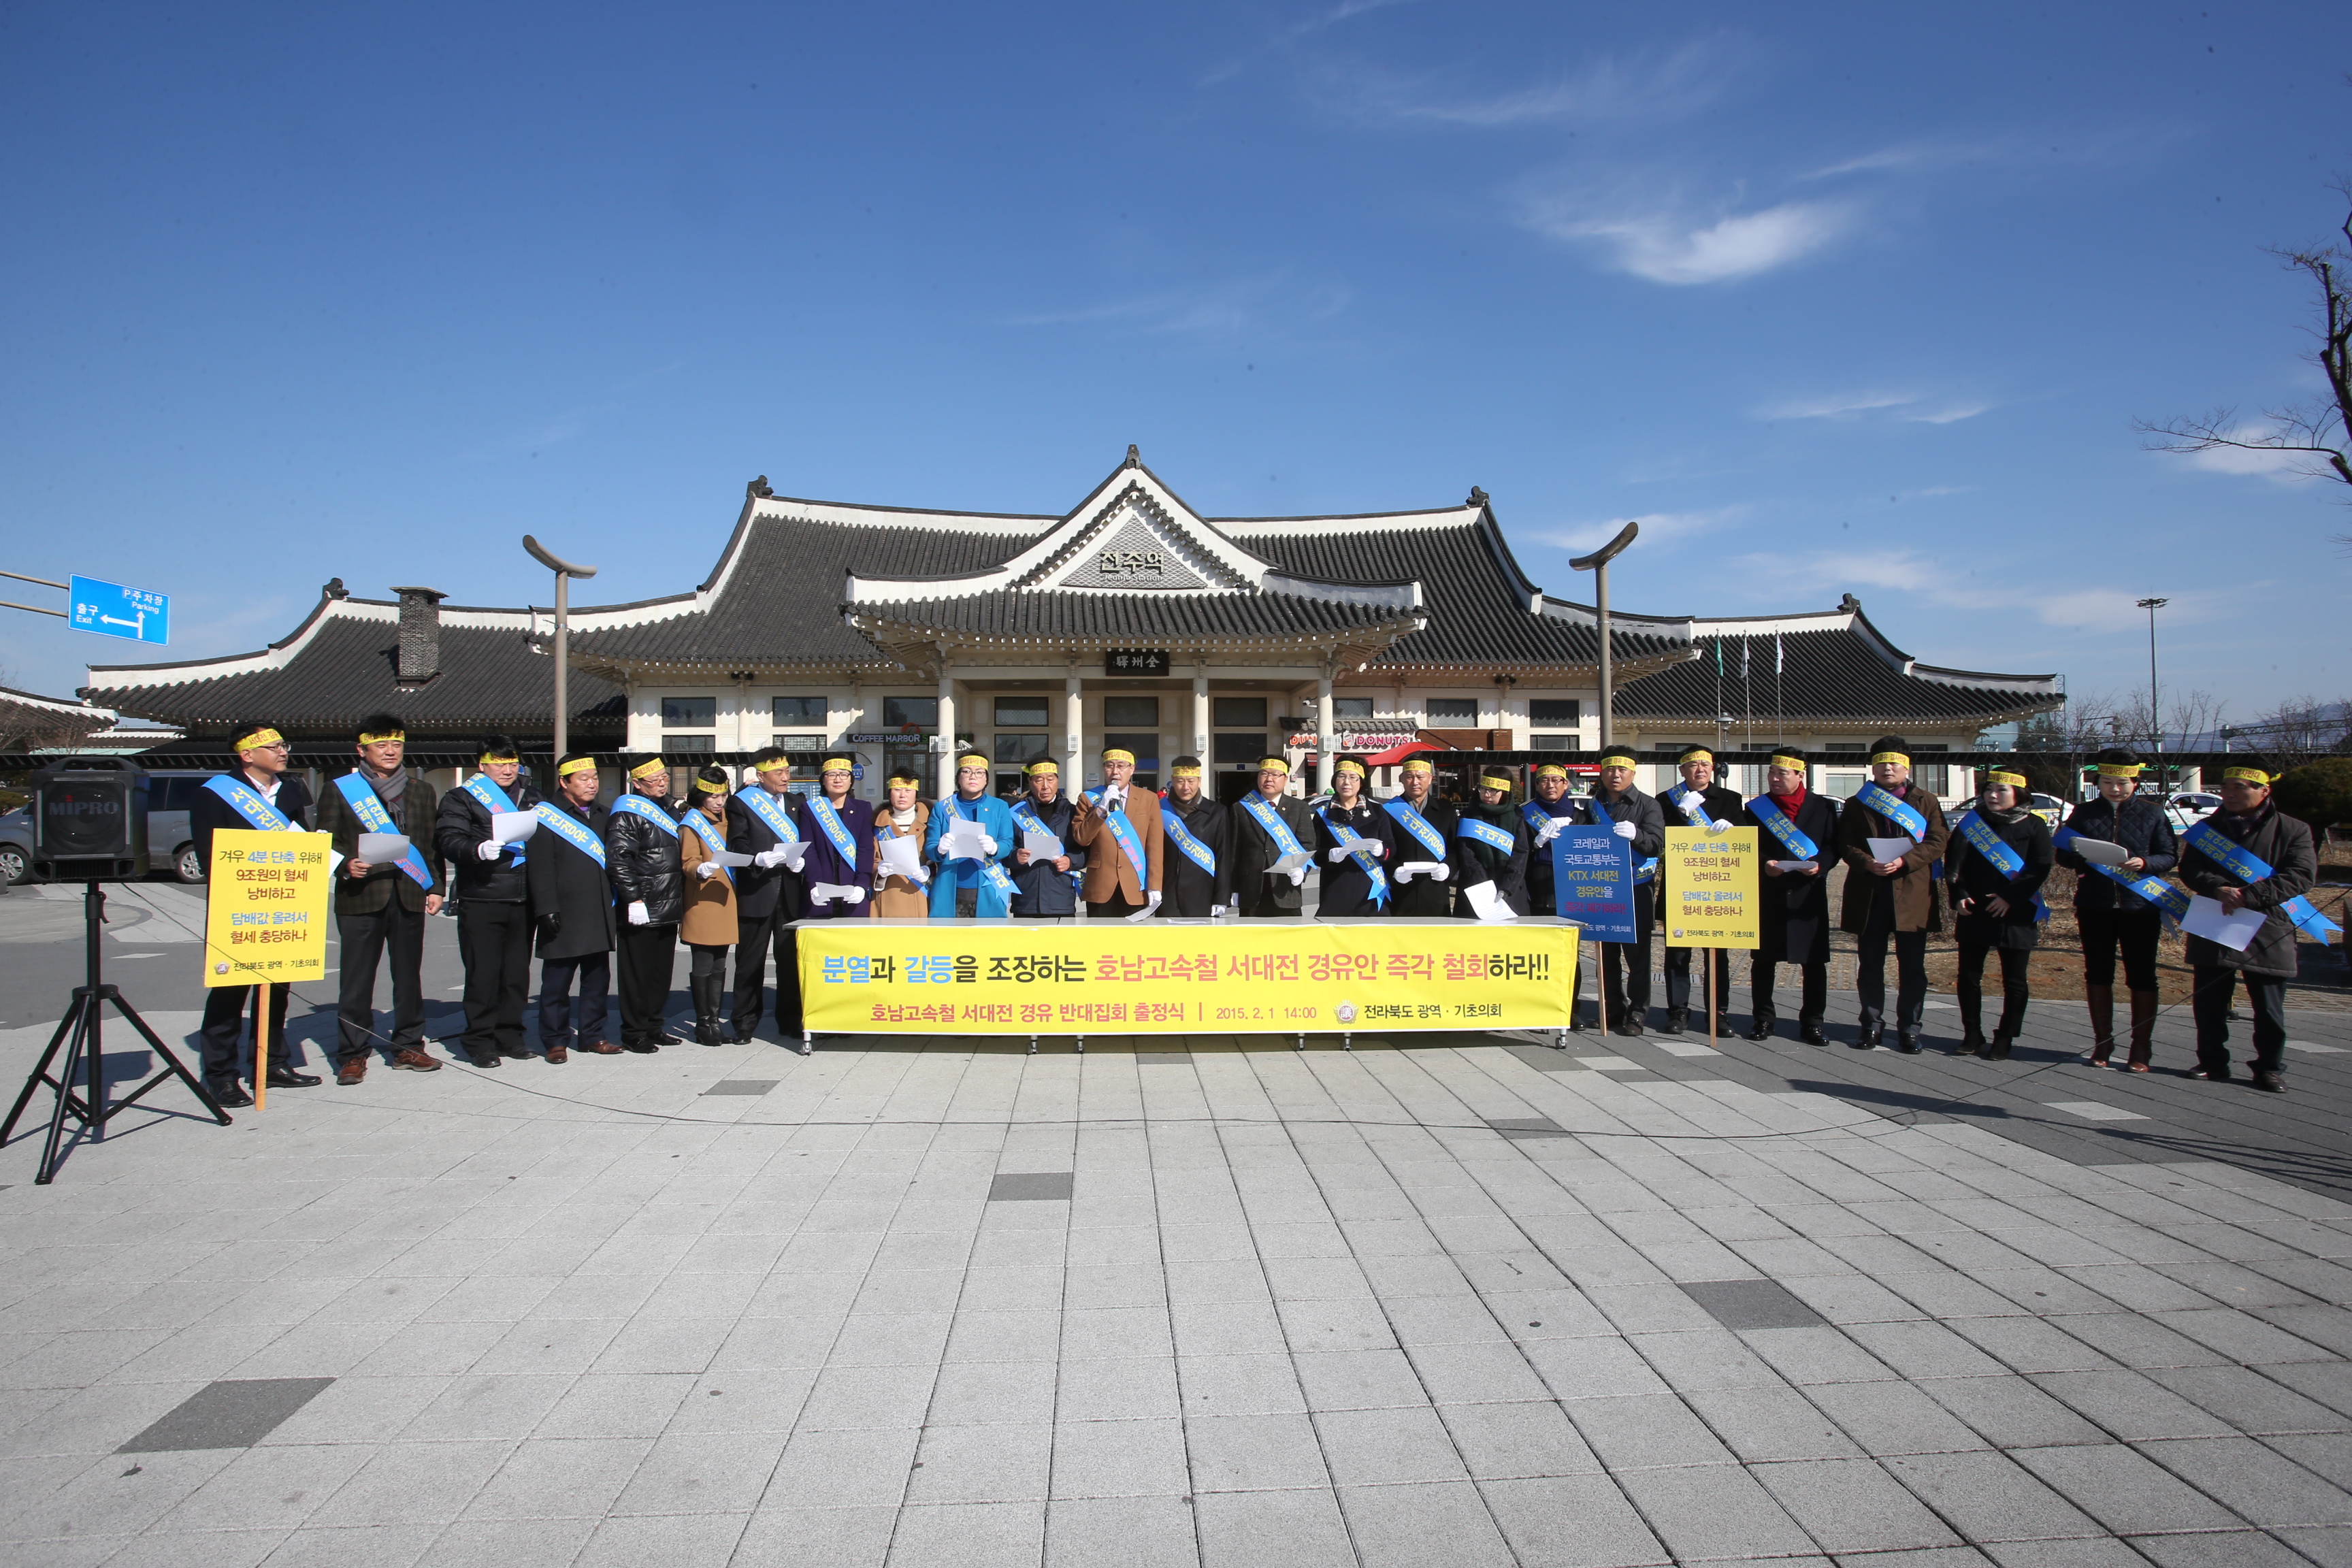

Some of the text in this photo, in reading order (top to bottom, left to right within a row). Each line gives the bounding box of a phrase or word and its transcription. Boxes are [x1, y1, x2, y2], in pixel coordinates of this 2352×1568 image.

[1100, 551, 1165, 574] 전주역
[1133, 574, 1163, 582] Station
[132, 589, 163, 606] 주차장
[77, 603, 99, 616] 출구
[131, 601, 160, 615] Parking
[76, 615, 93, 624] Exit
[248, 733, 268, 745] 서대전
[852, 734, 884, 742] COFFEE
[885, 734, 921, 742] HARBOR
[1356, 735, 1409, 746] DONUTS
[571, 760, 587, 770] 서대전
[2234, 769, 2261, 780] 결사반대
[700, 782, 713, 791] 서대전
[714, 783, 723, 792] 경유
[1487, 778, 1495, 786] 경유
[472, 785, 493, 804] 사장
[1871, 787, 1903, 808] 최연혜
[353, 800, 379, 832] 코레일
[365, 795, 391, 825] 최연혜
[1866, 796, 1916, 830] 코레일 사장
[751, 793, 799, 844] 서대전경유
[812, 795, 847, 844] 서대전경유
[1108, 818, 1124, 836] 사장
[1401, 810, 1446, 856] 서대전경유
[1974, 819, 2002, 845] 최연혜
[1169, 819, 1212, 864] 서대전경유
[1573, 837, 1611, 850] 코레일과
[1765, 817, 1807, 858] 코레일 사장
[2204, 828, 2237, 852] 최연혜
[1671, 843, 1751, 853] 겨우 4분 단축 위해
[1965, 826, 2011, 871] 코레일 사장
[219, 849, 322, 864] 겨우 4분 단축 위해
[1564, 853, 1620, 866] 국토교통부는
[1683, 857, 1740, 868] 9조원의 혈세
[2195, 837, 2253, 878] 코레일 사장
[235, 868, 308, 882] 9조원의 혈세
[1568, 870, 1619, 882] KTX 서대전
[1693, 871, 1731, 882] 낭비하고
[248, 887, 296, 900] 낭비하고
[1575, 885, 1614, 898] 경유안을
[1682, 891, 1743, 902] 담배값 올려서
[1565, 901, 1628, 915] 즉각 폐기하라!
[1682, 905, 1743, 917] 혈세 충당하나
[231, 911, 308, 926] 담배값 올려서
[1610, 925, 1631, 933] 기초의회
[1730, 930, 1754, 938] 기초의회
[230, 929, 308, 944] 혈세 충당하나
[233, 958, 319, 972] 전라북도 광역 기초의회
[821, 953, 1549, 984] 분열과 갈등을 조장하는 호남고속철 서대전 경유안 즉각 철회하라!!
[870, 1002, 1317, 1023] 호남고속철 서대전 경유 반대집회 출정식 2015. 2. 1 14:00
[1364, 1003, 1502, 1019] 전라북도 광역 기초의회
